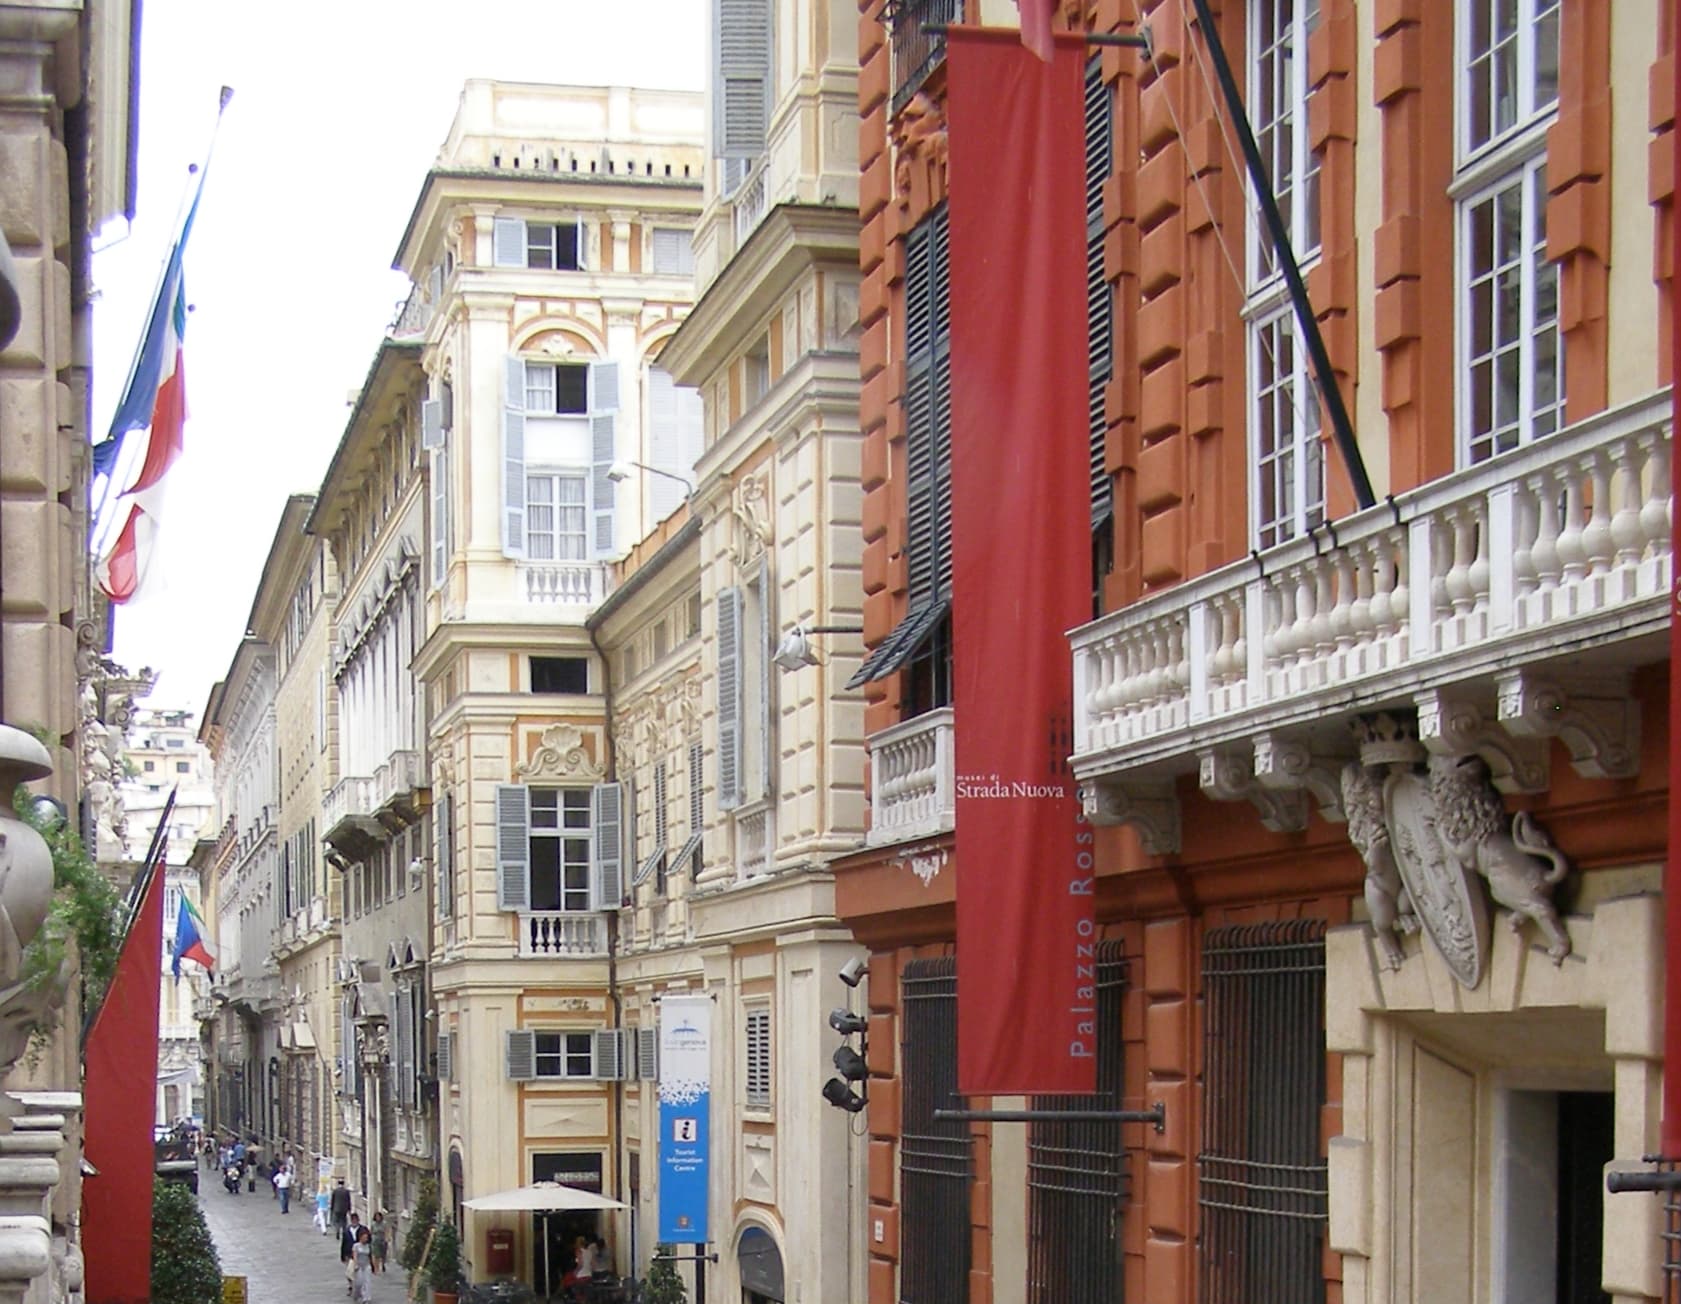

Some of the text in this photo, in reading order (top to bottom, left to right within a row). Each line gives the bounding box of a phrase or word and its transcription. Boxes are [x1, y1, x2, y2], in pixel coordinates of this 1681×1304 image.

[956, 781, 1065, 799] Strada Nuova
[1069, 918, 1094, 1057] Palazzo
